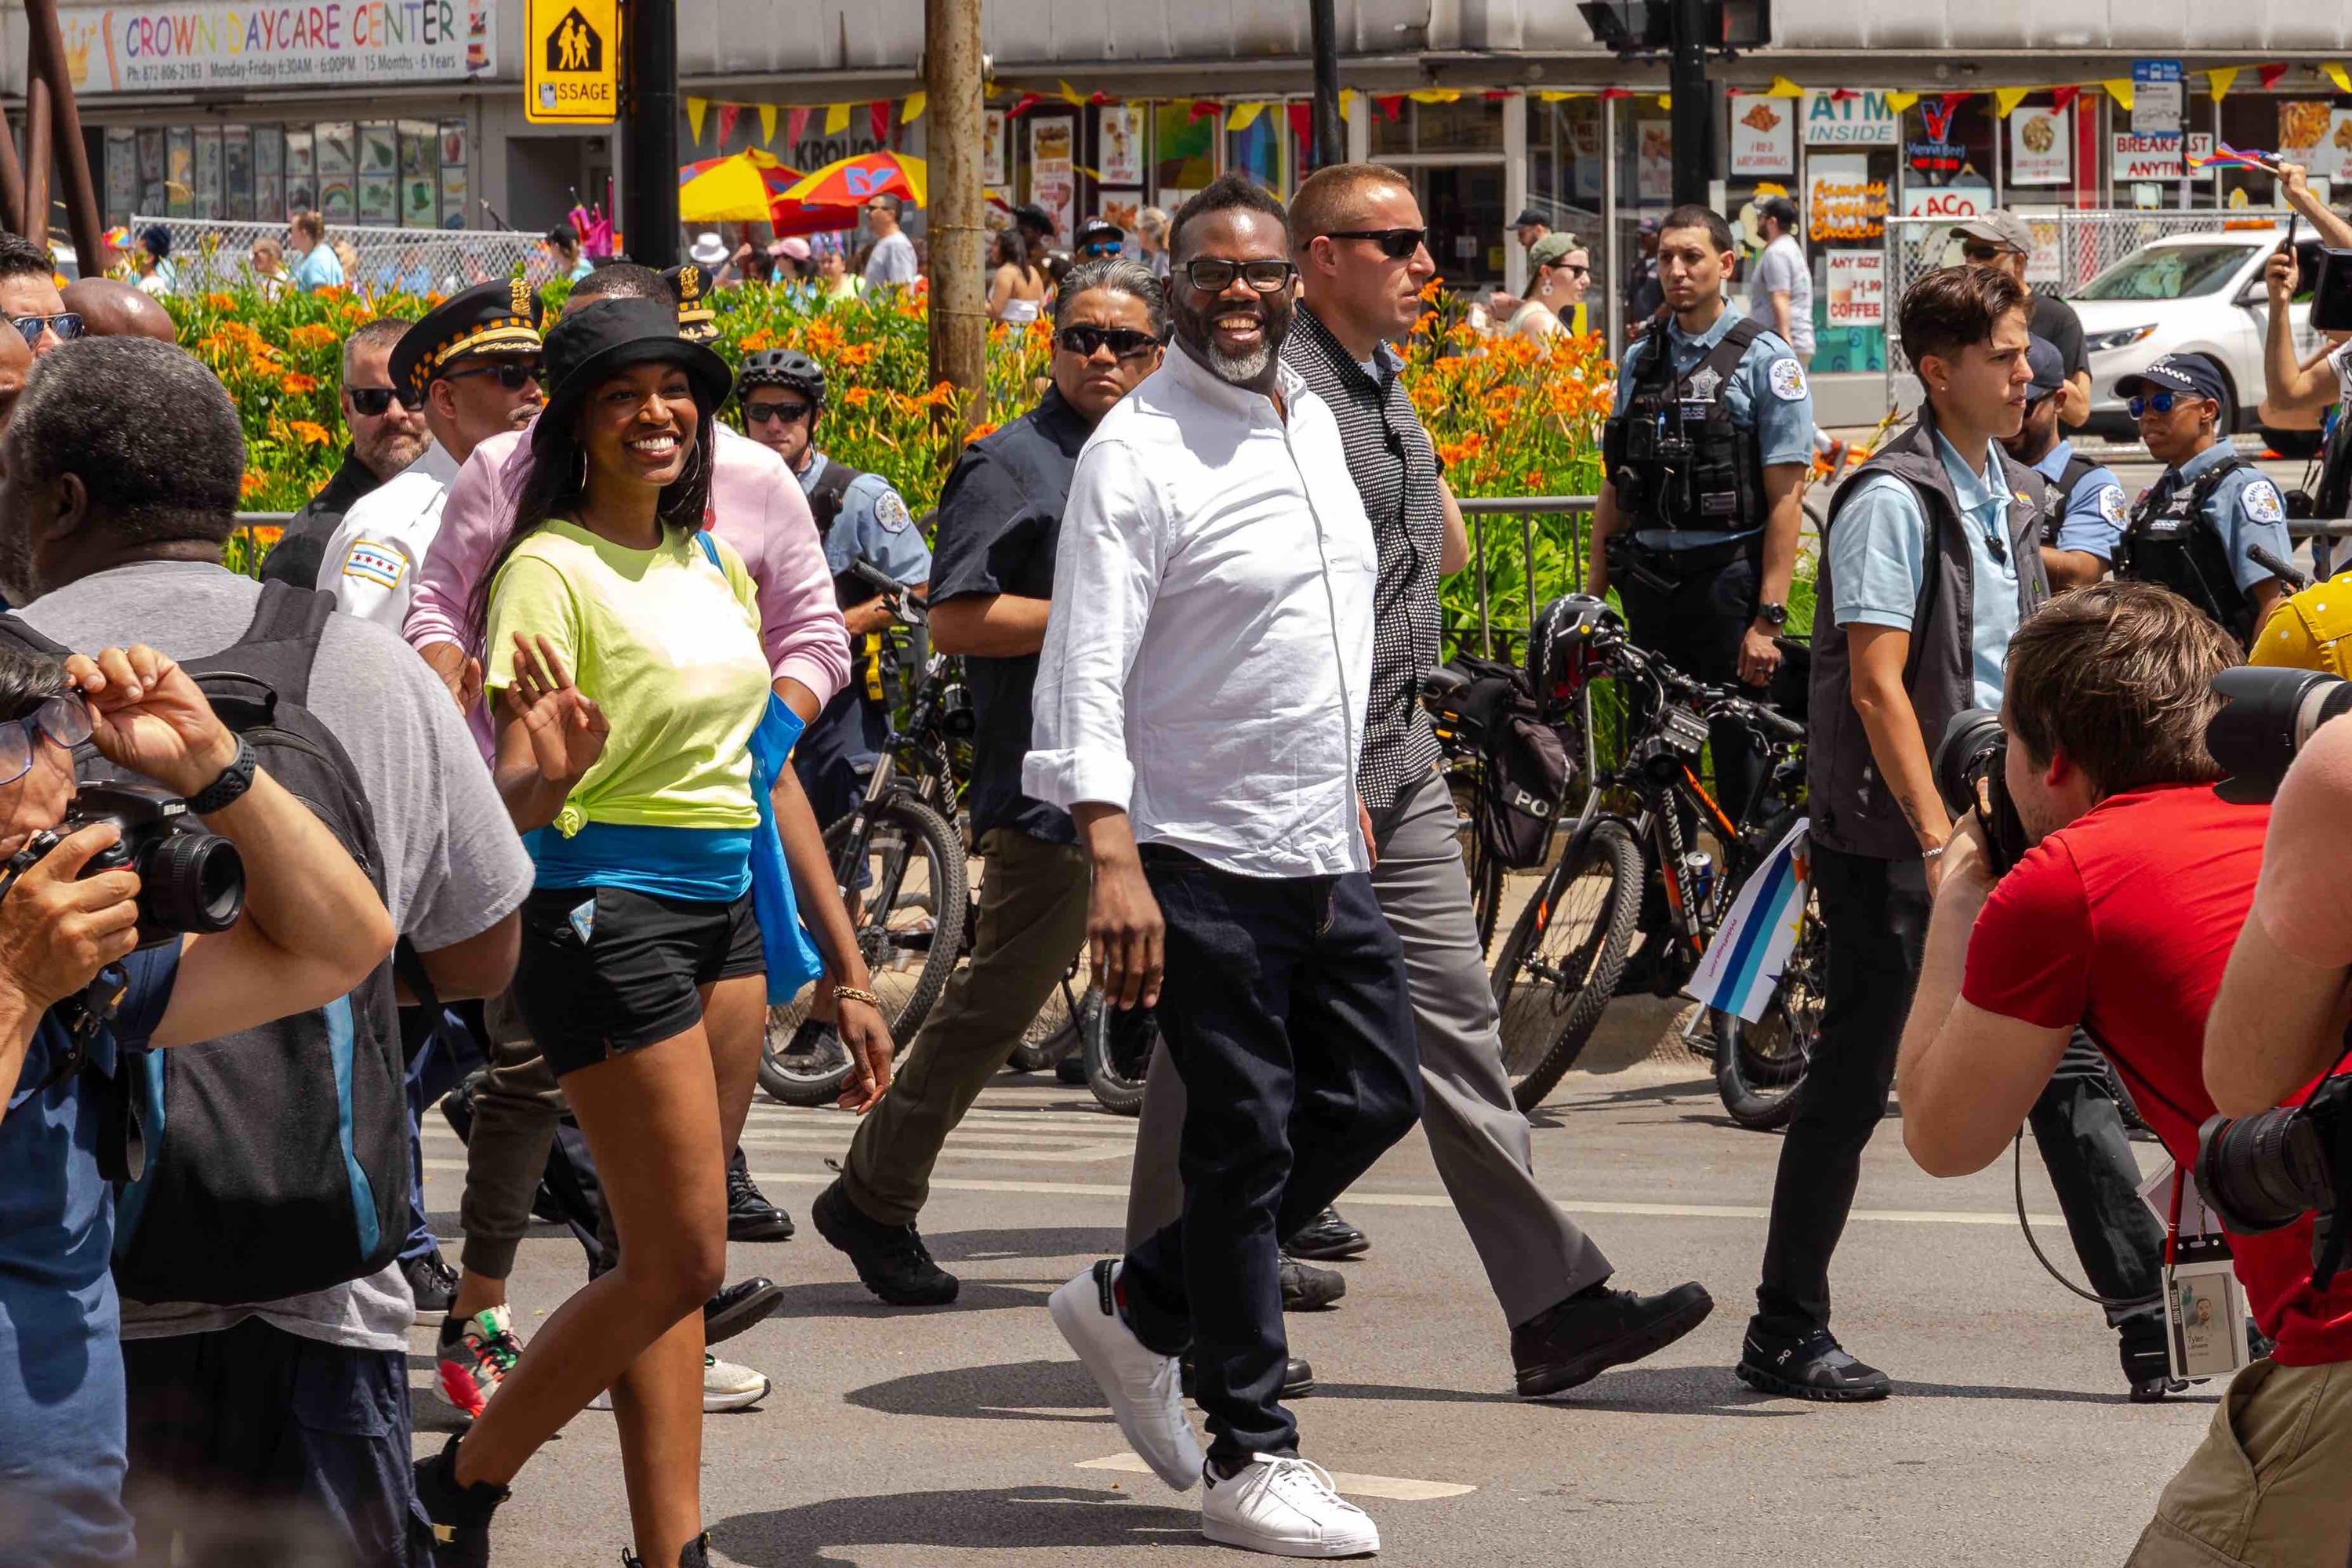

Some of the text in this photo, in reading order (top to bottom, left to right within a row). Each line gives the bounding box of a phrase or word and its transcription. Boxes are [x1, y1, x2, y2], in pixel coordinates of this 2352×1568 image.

[126, 0, 454, 57] CROWN DAYCARE CENTER
[278, 57, 312, 75] 6:30AM
[320, 55, 355, 73] 6:00PM
[378, 53, 413, 71] Months
[430, 52, 456, 69] Years
[539, 83, 609, 100] SSAGE
[1809, 125, 1893, 142] INSIDE
[2117, 136, 2208, 153] BREAKFST
[1809, 219, 1885, 241] Chicken
[1831, 256, 1880, 269] ANY SIZE
[1830, 303, 1881, 318] COFFEE
[1675, 852, 1696, 916] POLICE
